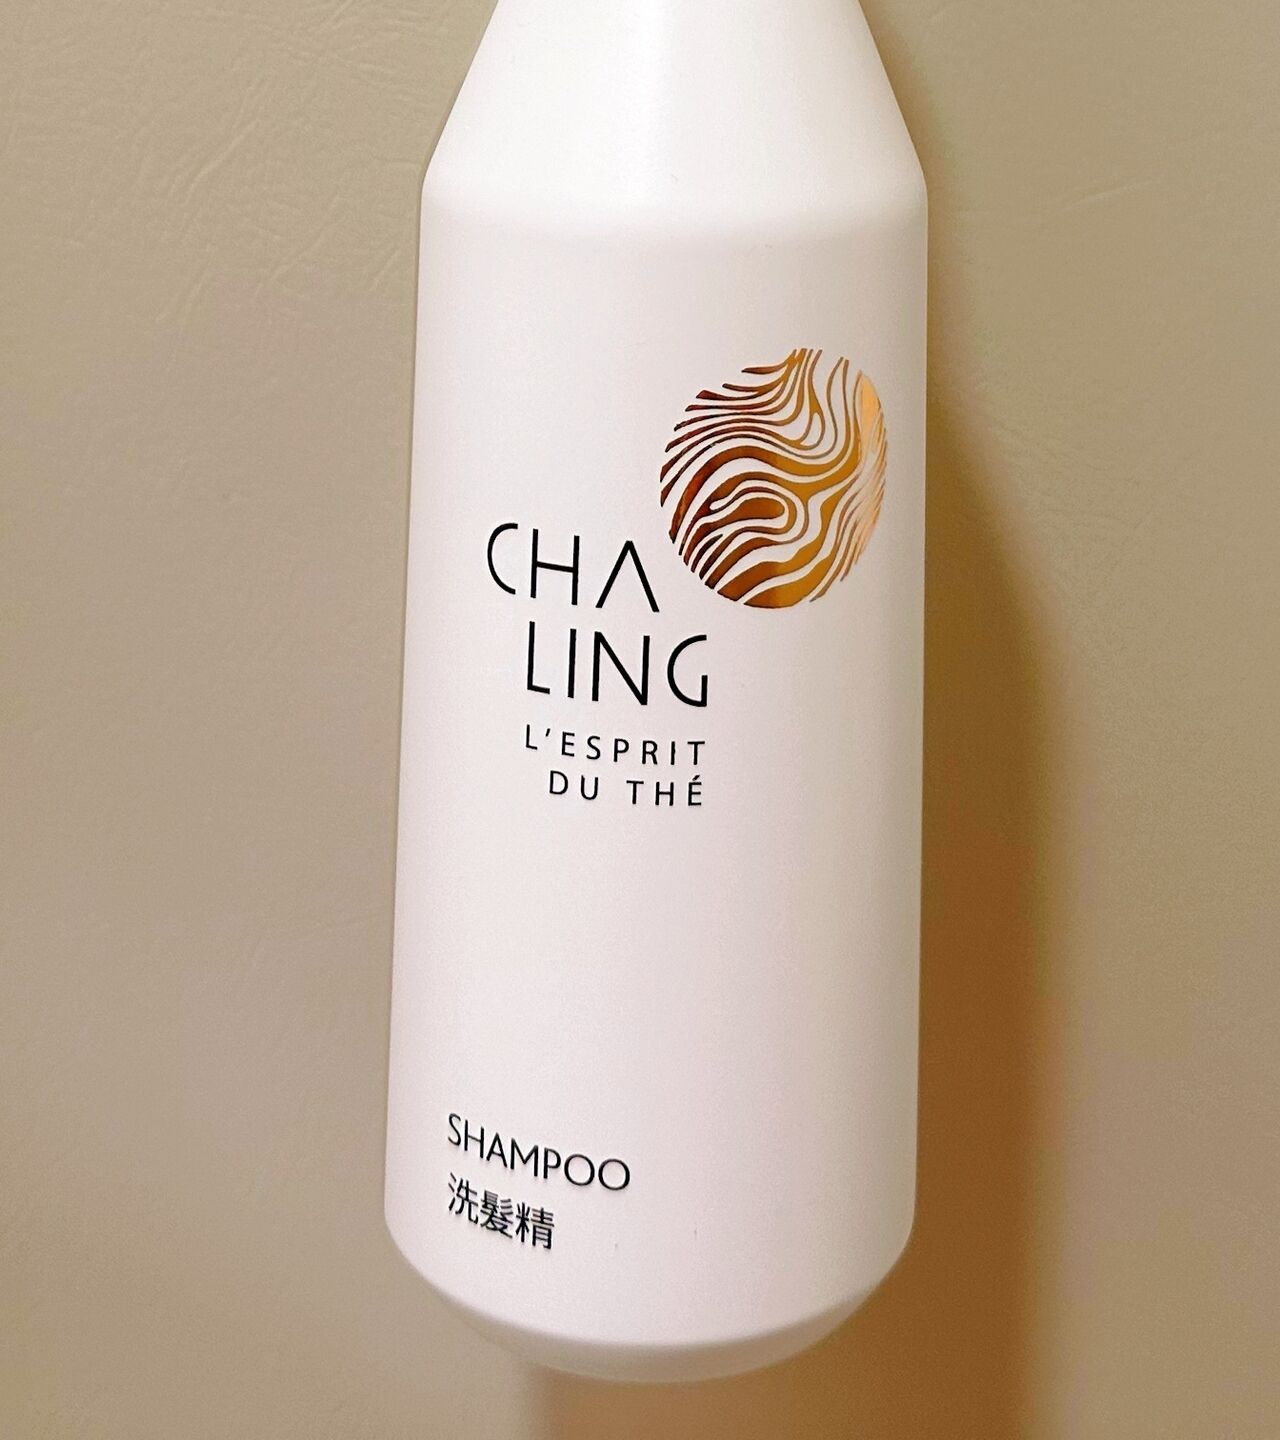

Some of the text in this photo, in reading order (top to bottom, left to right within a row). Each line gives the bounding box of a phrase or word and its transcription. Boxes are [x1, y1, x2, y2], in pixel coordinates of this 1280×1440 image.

[487, 522, 660, 613] CHA
[527, 621, 708, 707] LING
[525, 724, 705, 766] L'ESPRIT
[549, 770, 702, 807] DU THÉ
[448, 1113, 631, 1191] SHAMPOO
[448, 1172, 555, 1250] 洗髮精
